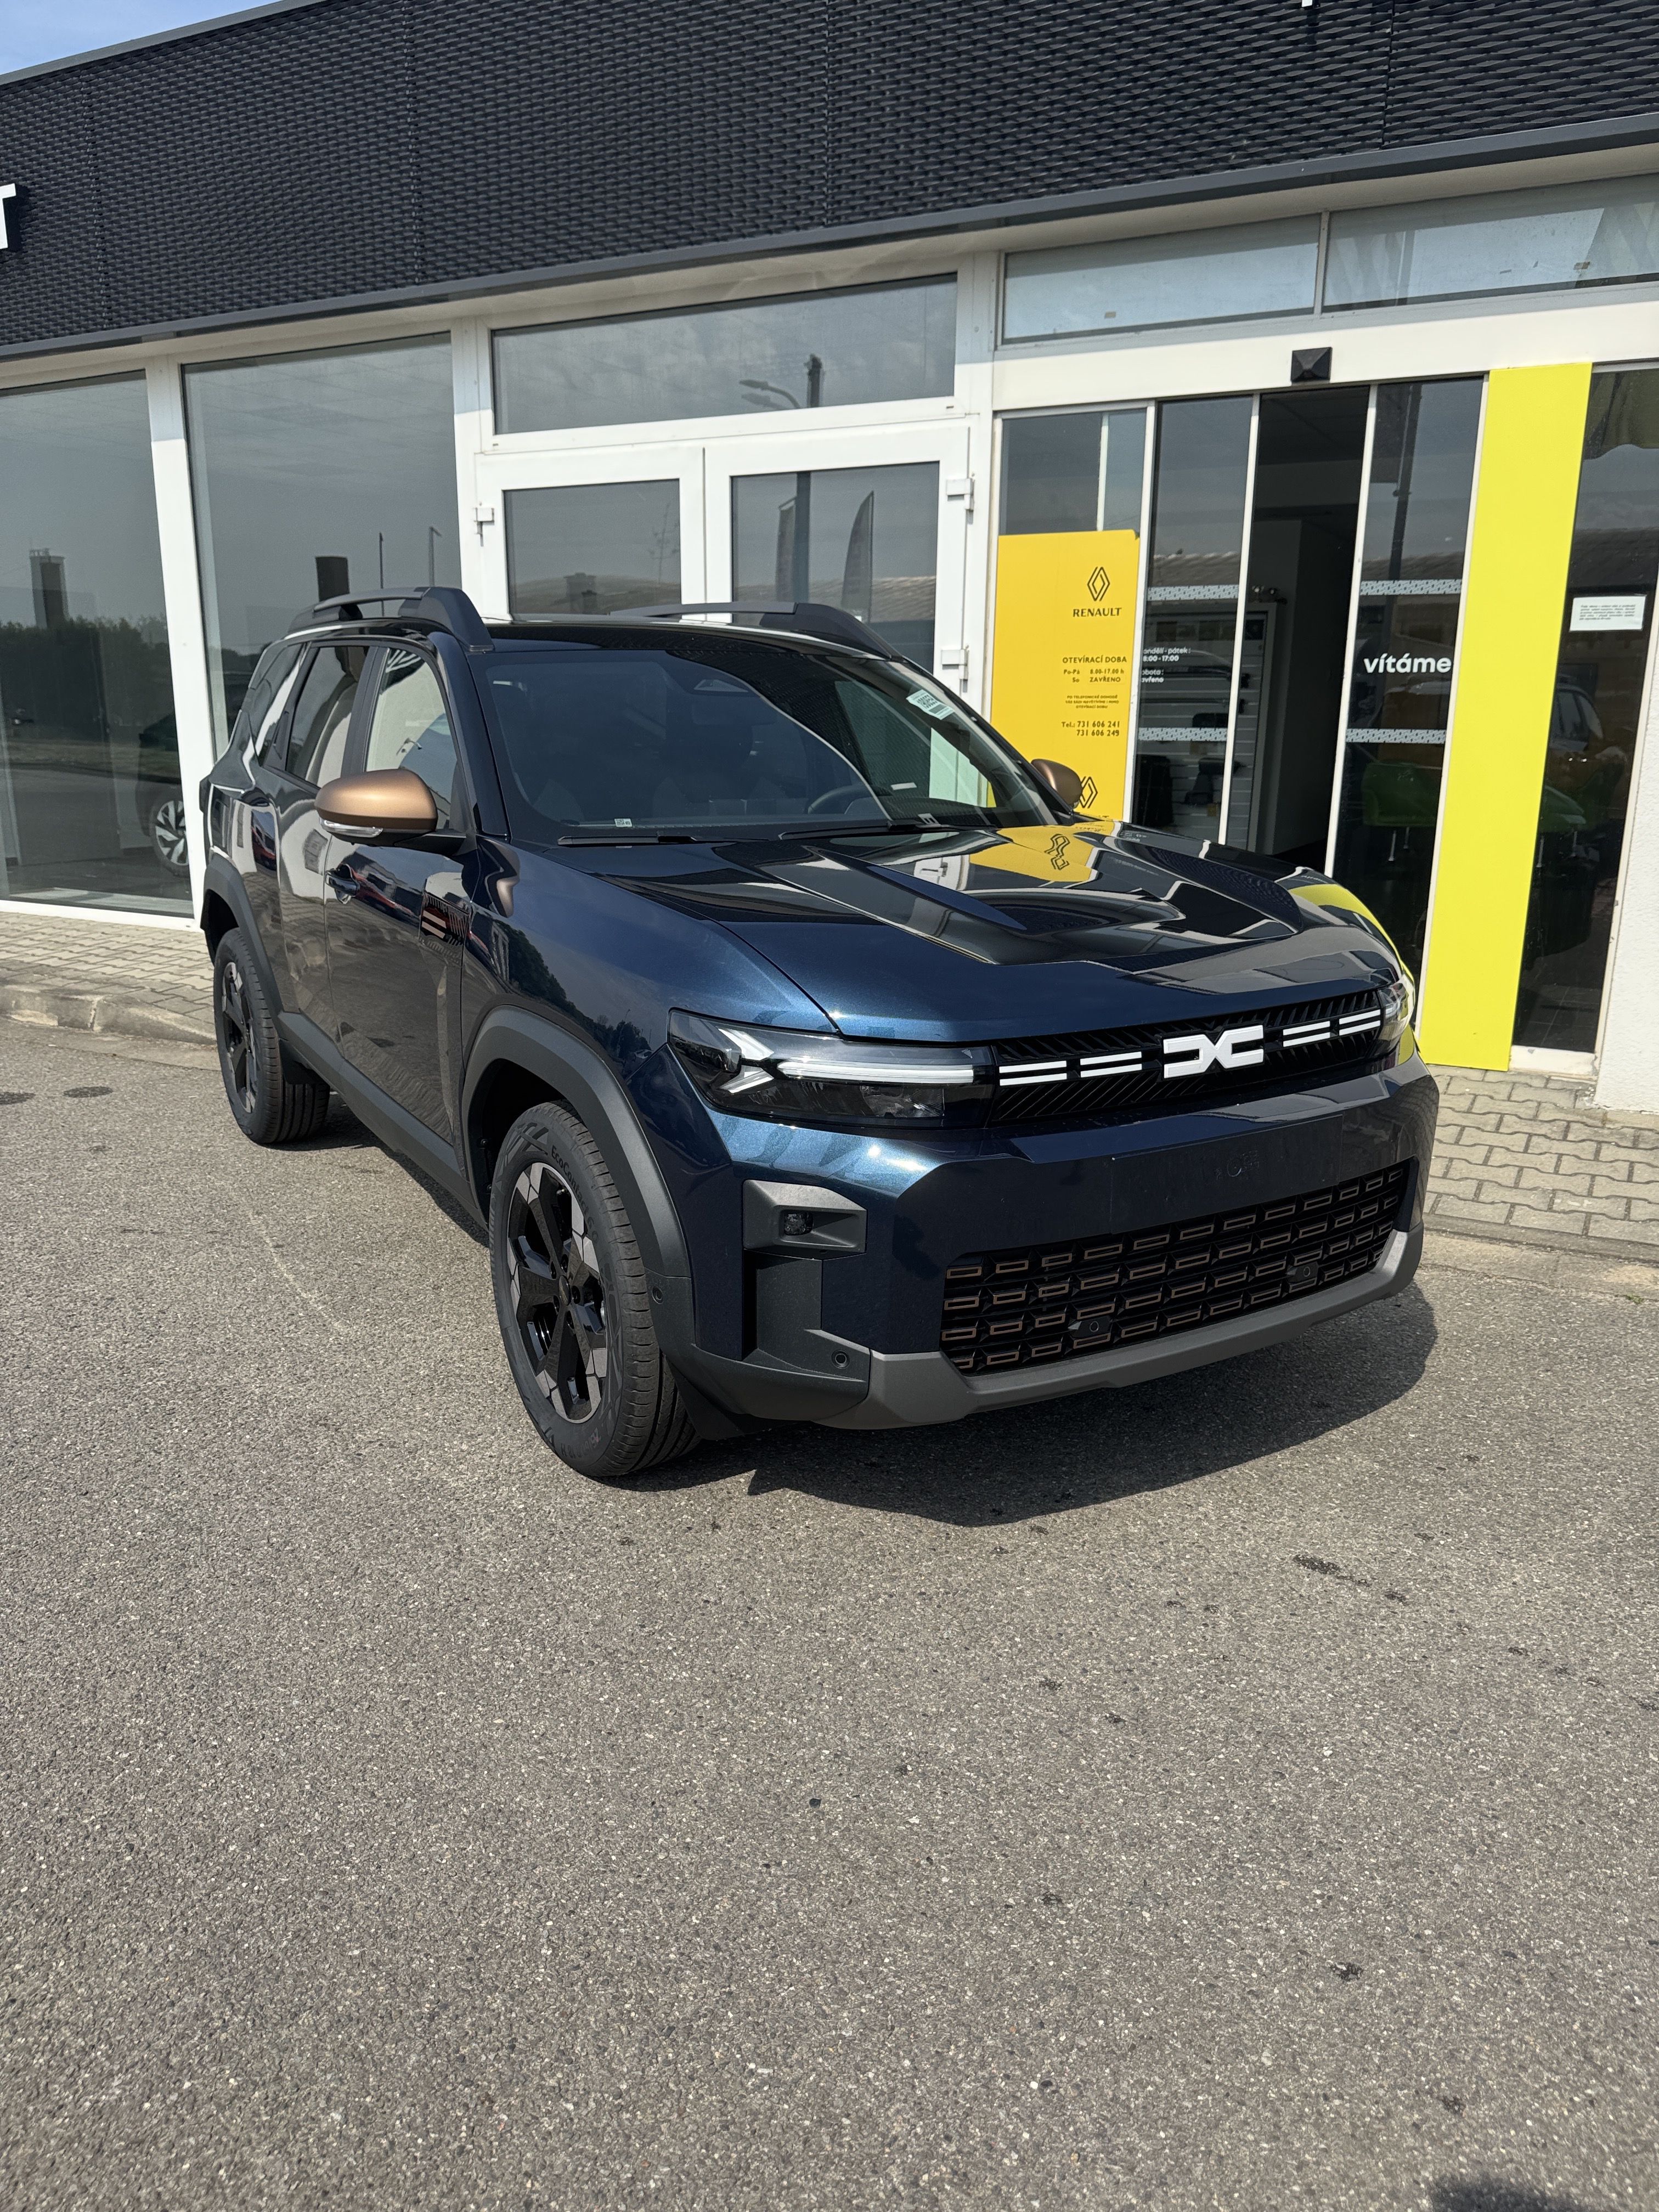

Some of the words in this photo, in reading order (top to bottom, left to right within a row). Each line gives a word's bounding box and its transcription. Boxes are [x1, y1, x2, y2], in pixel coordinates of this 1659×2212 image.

[1073, 607, 1122, 617] RENAULT
[1062, 654, 1103, 663] OTEVÍRACÍ
[1363, 653, 1452, 673] vítáme
